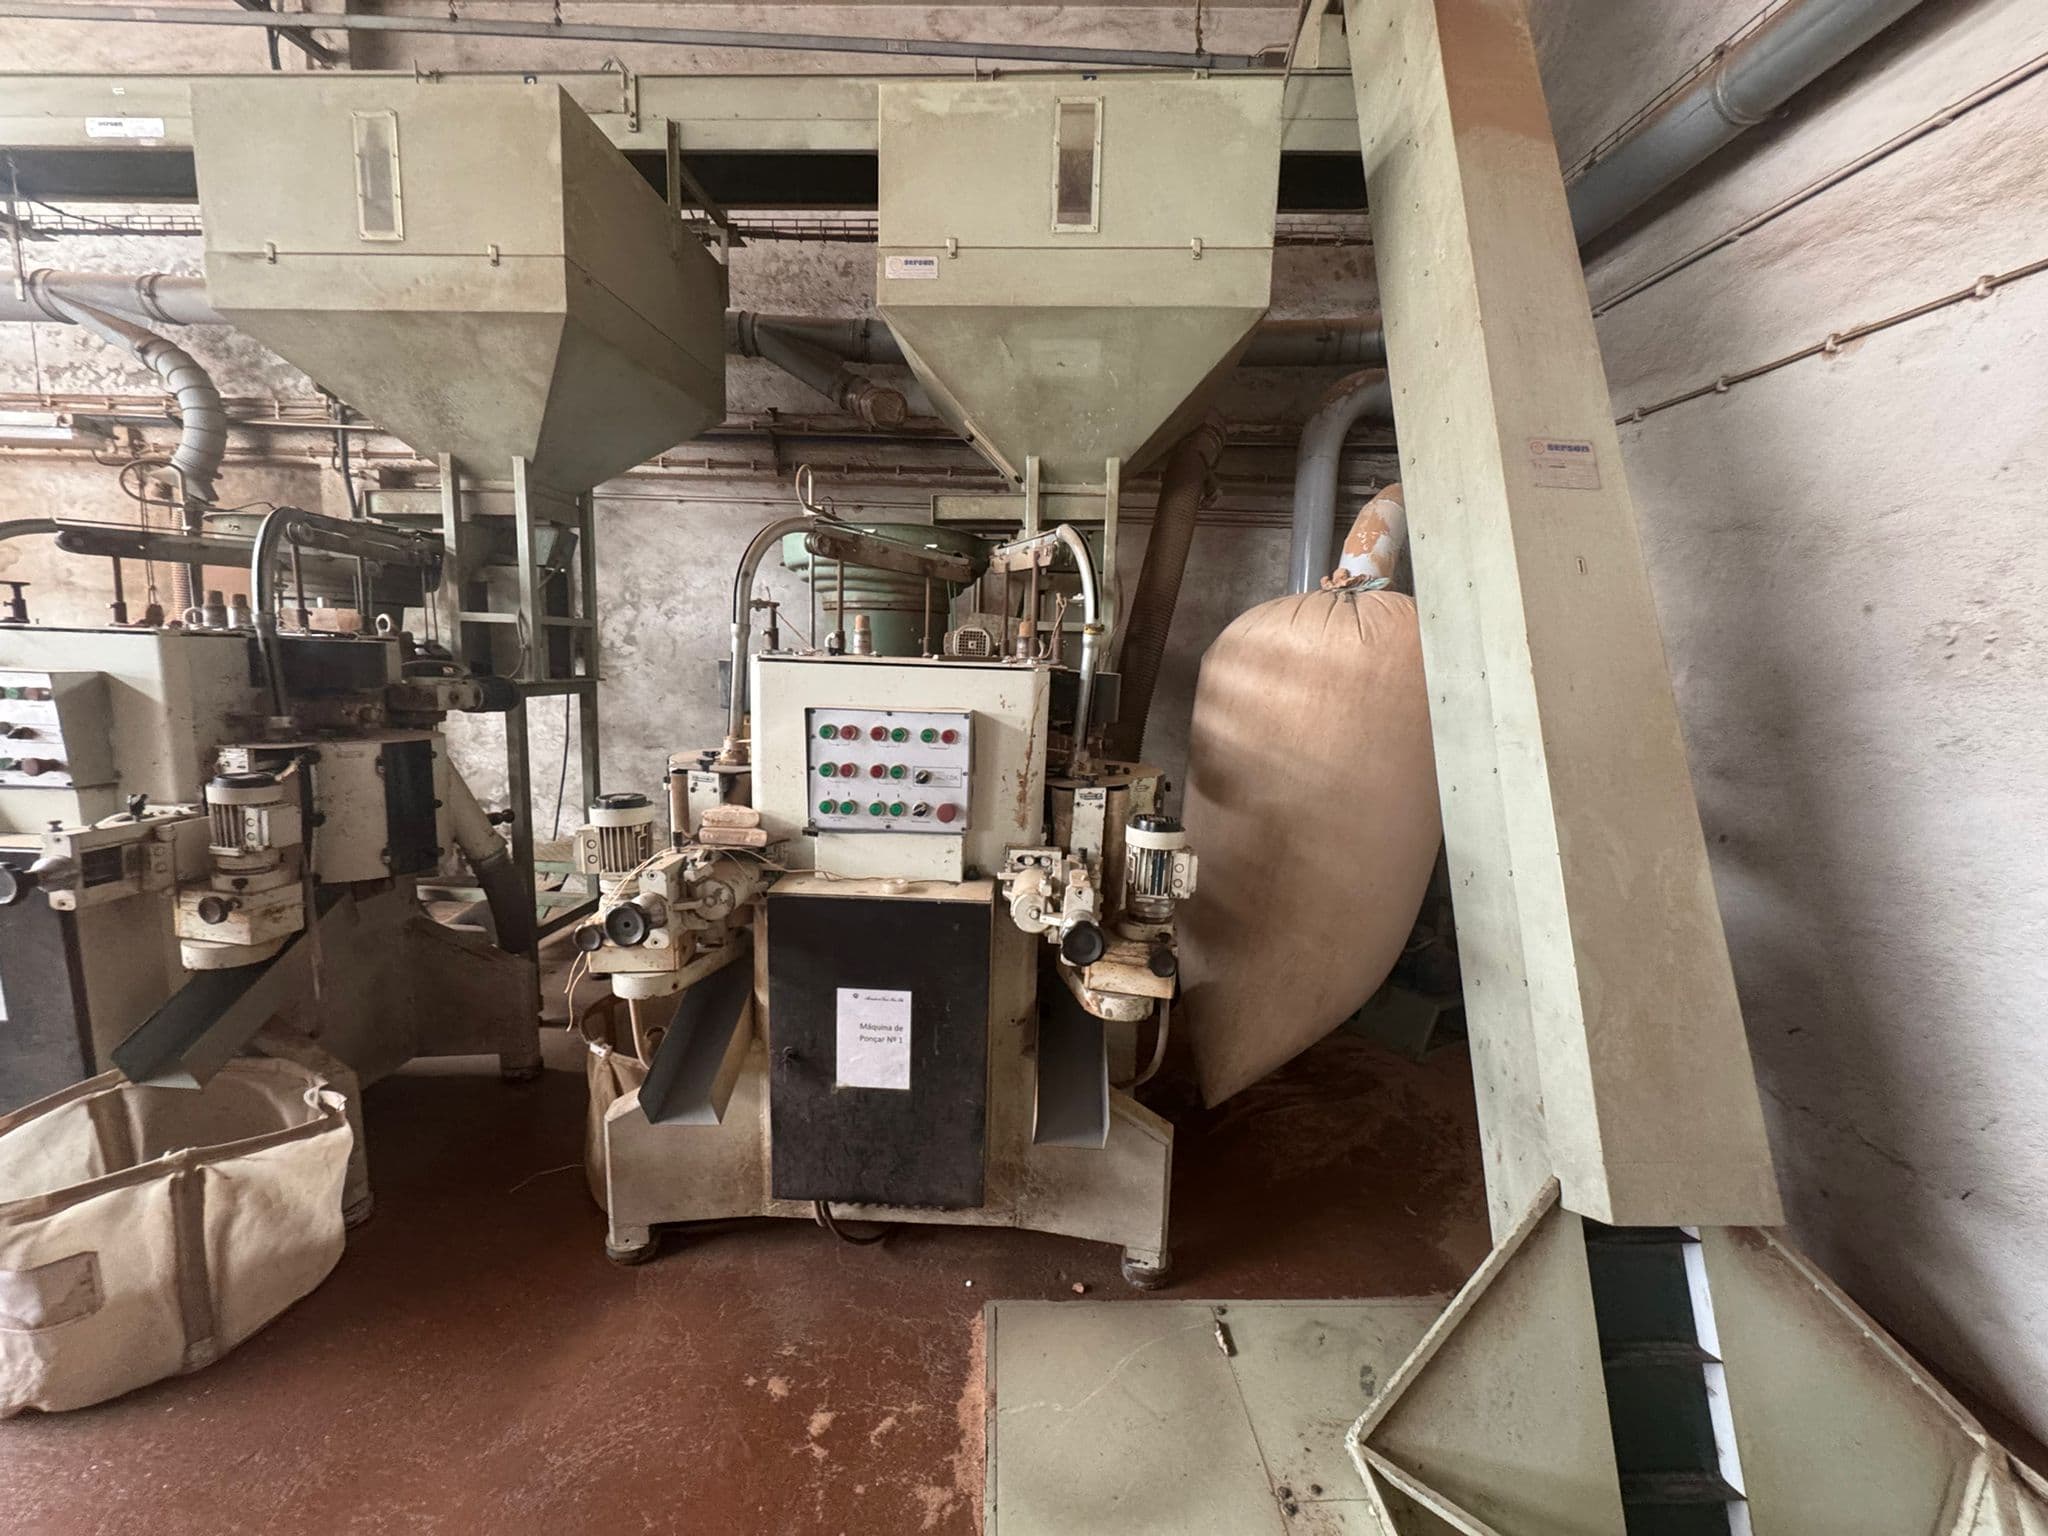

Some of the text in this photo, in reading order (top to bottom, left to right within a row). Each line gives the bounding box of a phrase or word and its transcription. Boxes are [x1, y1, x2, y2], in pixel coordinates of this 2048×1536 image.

[859, 1022, 904, 1032] Máquina de
[859, 1035, 885, 1044] Ponçar
